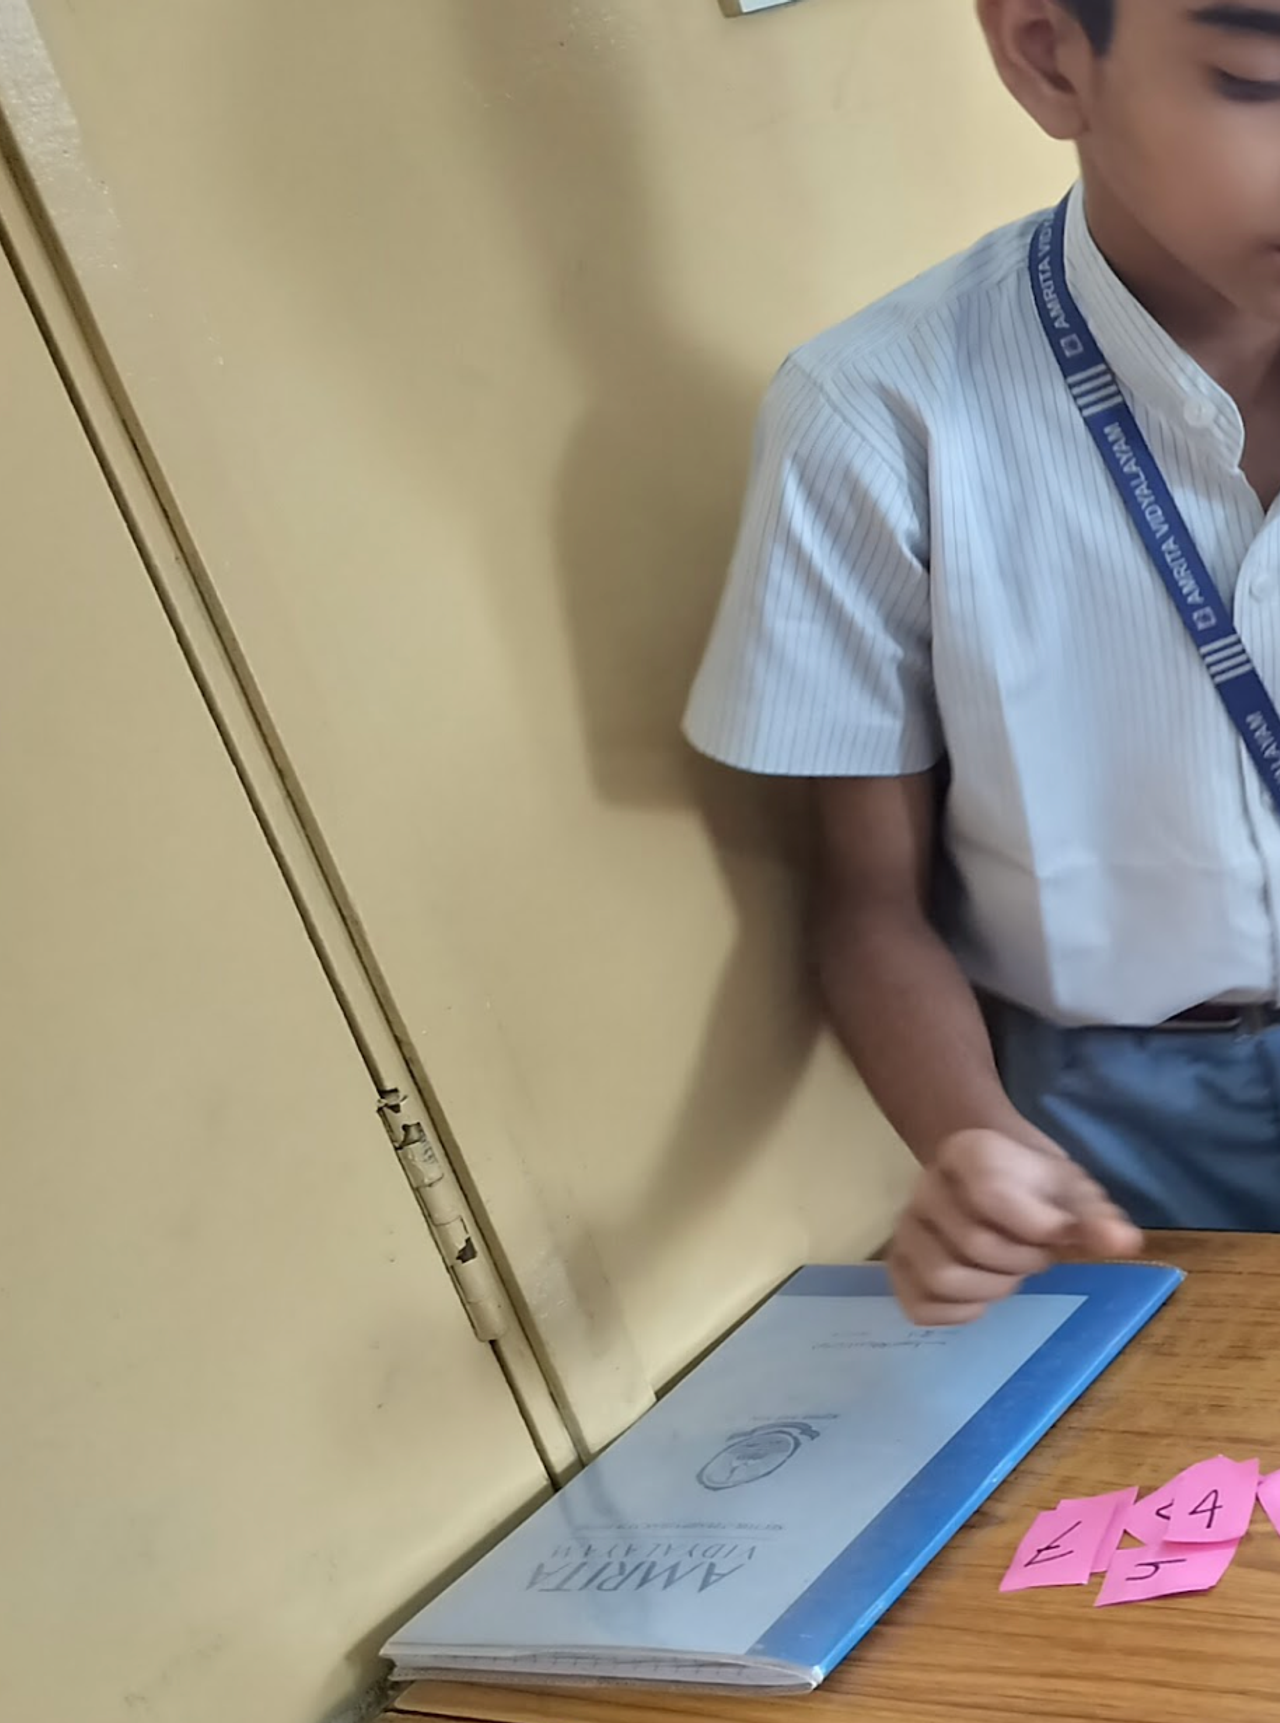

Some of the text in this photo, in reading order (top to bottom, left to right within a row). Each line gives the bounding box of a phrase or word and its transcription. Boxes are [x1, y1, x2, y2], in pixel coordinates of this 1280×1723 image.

[1038, 257, 1070, 329] AMRITA
[1103, 422, 1204, 605] AMRITA VIDYALAYAM
[525, 1561, 746, 1593] AMRITA
